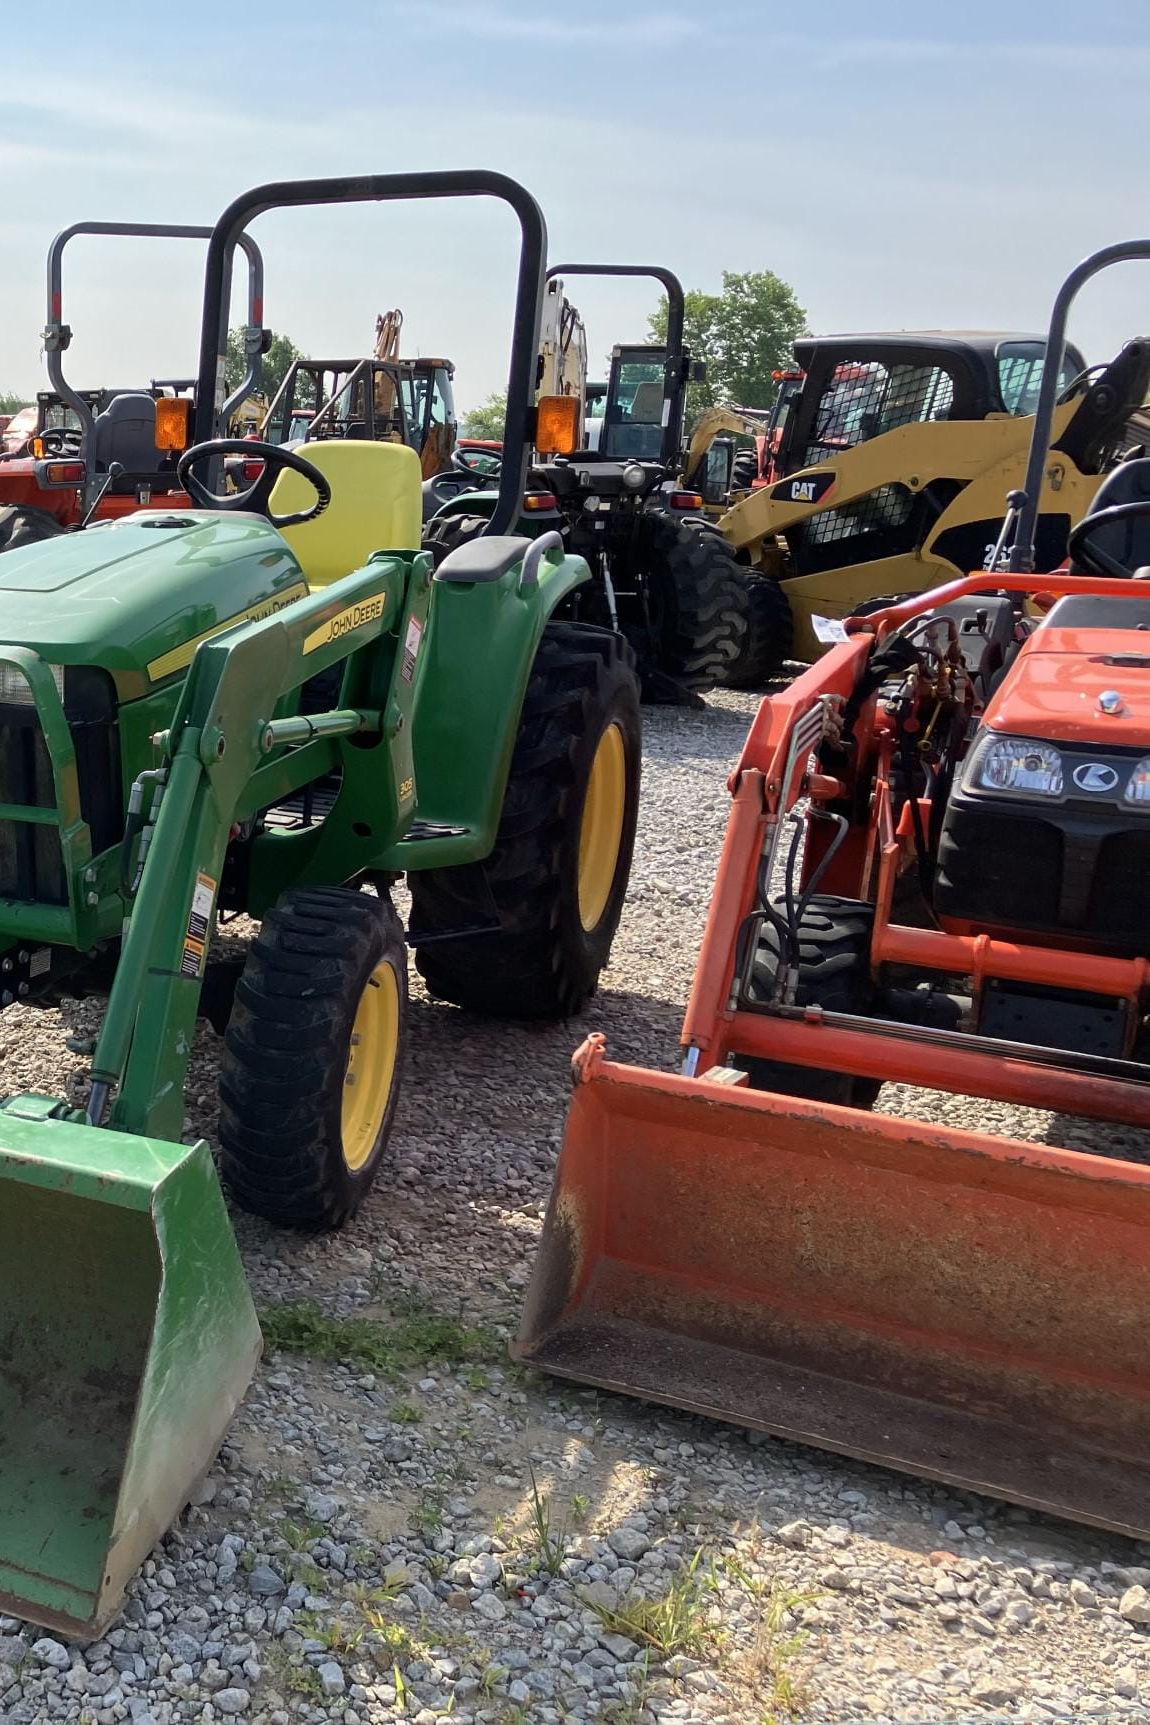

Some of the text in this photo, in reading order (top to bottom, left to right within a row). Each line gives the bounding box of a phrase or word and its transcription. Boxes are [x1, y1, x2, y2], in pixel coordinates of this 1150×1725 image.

[791, 481, 817, 501] CAT
[327, 600, 382, 641] JOHN DEERE
